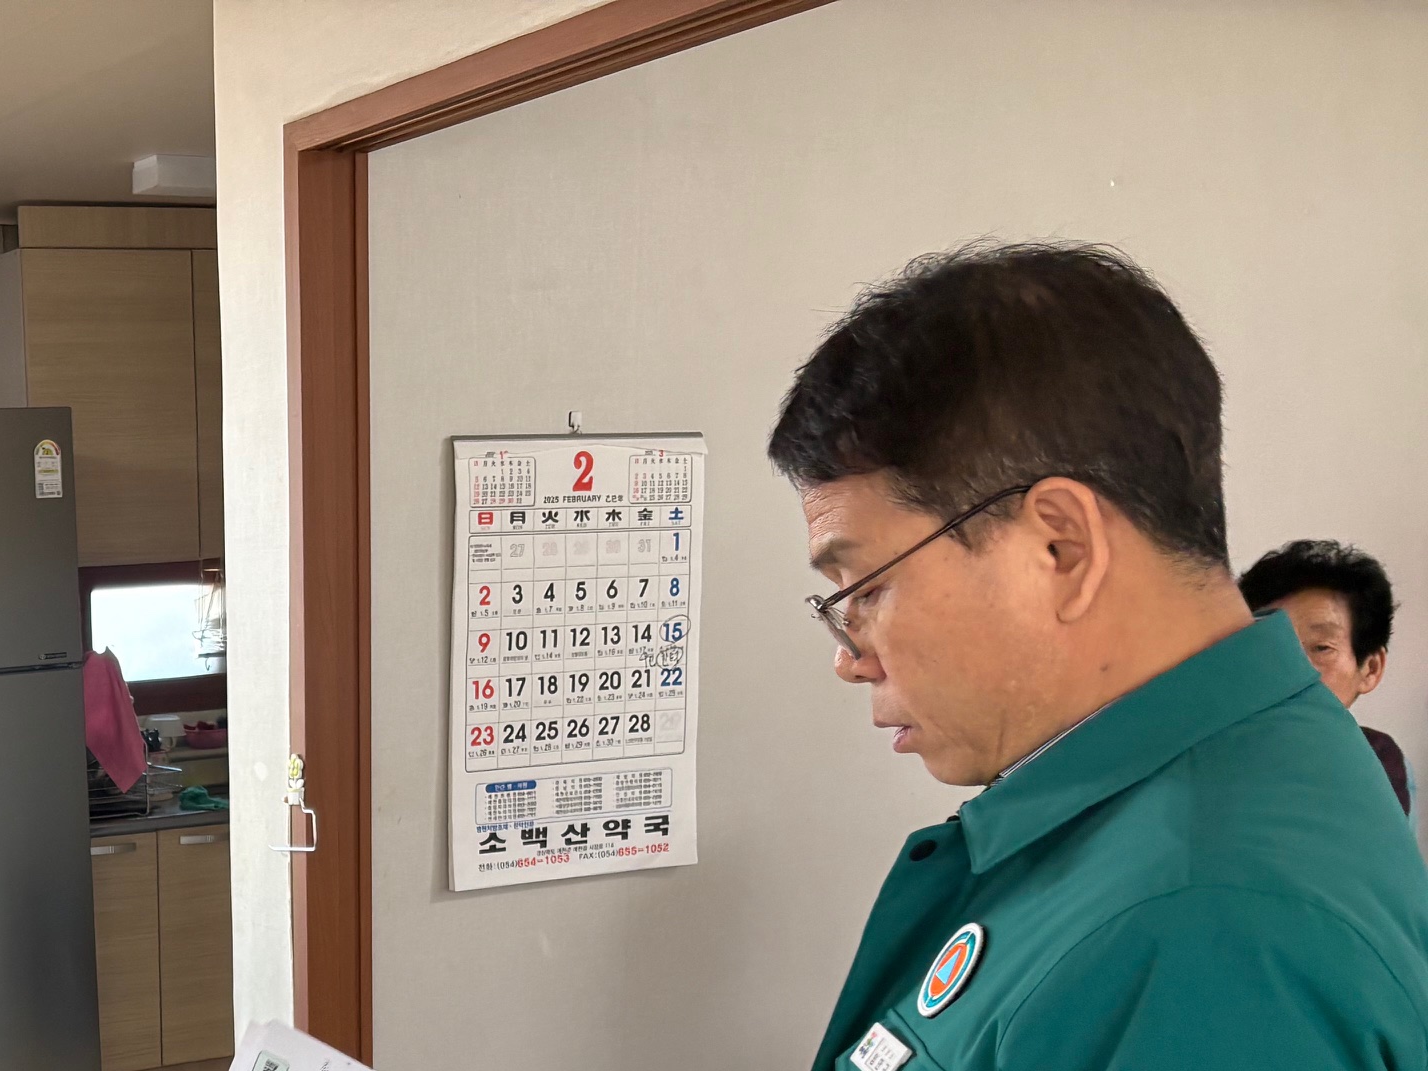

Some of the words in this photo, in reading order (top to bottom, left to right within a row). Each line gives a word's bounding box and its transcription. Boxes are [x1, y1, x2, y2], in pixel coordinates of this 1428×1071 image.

[572, 451, 593, 492] 2
[563, 495, 601, 503] FEBRUARY
[478, 512, 493, 525] 日
[510, 511, 525, 524] 月
[542, 511, 559, 524] 火
[574, 510, 590, 522] 水
[606, 509, 622, 521] 木
[638, 508, 653, 520] 金
[668, 507, 684, 520] 土
[673, 532, 679, 551] 1
[479, 585, 490, 606] 2
[512, 584, 523, 604] 3
[544, 582, 555, 602] 4
[575, 581, 587, 601] 5
[607, 579, 618, 599] 6
[639, 579, 649, 597] 7
[670, 577, 680, 596] 8
[478, 633, 490, 653] 9
[506, 631, 527, 651] 10
[540, 629, 558, 649] 11
[570, 627, 590, 647] 12
[601, 626, 621, 645] 13
[632, 624, 652, 643] 14
[663, 622, 682, 641] 15
[472, 679, 494, 700] 16
[505, 677, 526, 697] 17
[538, 675, 558, 695] 18
[569, 673, 589, 693] 19
[599, 671, 621, 690] 20
[631, 669, 650, 688] 21
[660, 667, 682, 686] 22
[471, 726, 494, 747] 23
[503, 723, 527, 743] 24
[535, 721, 558, 740] 25
[567, 718, 590, 738] 26
[598, 716, 620, 735] 27
[629, 714, 650, 733] 28
[479, 815, 669, 854] 소백산약국
